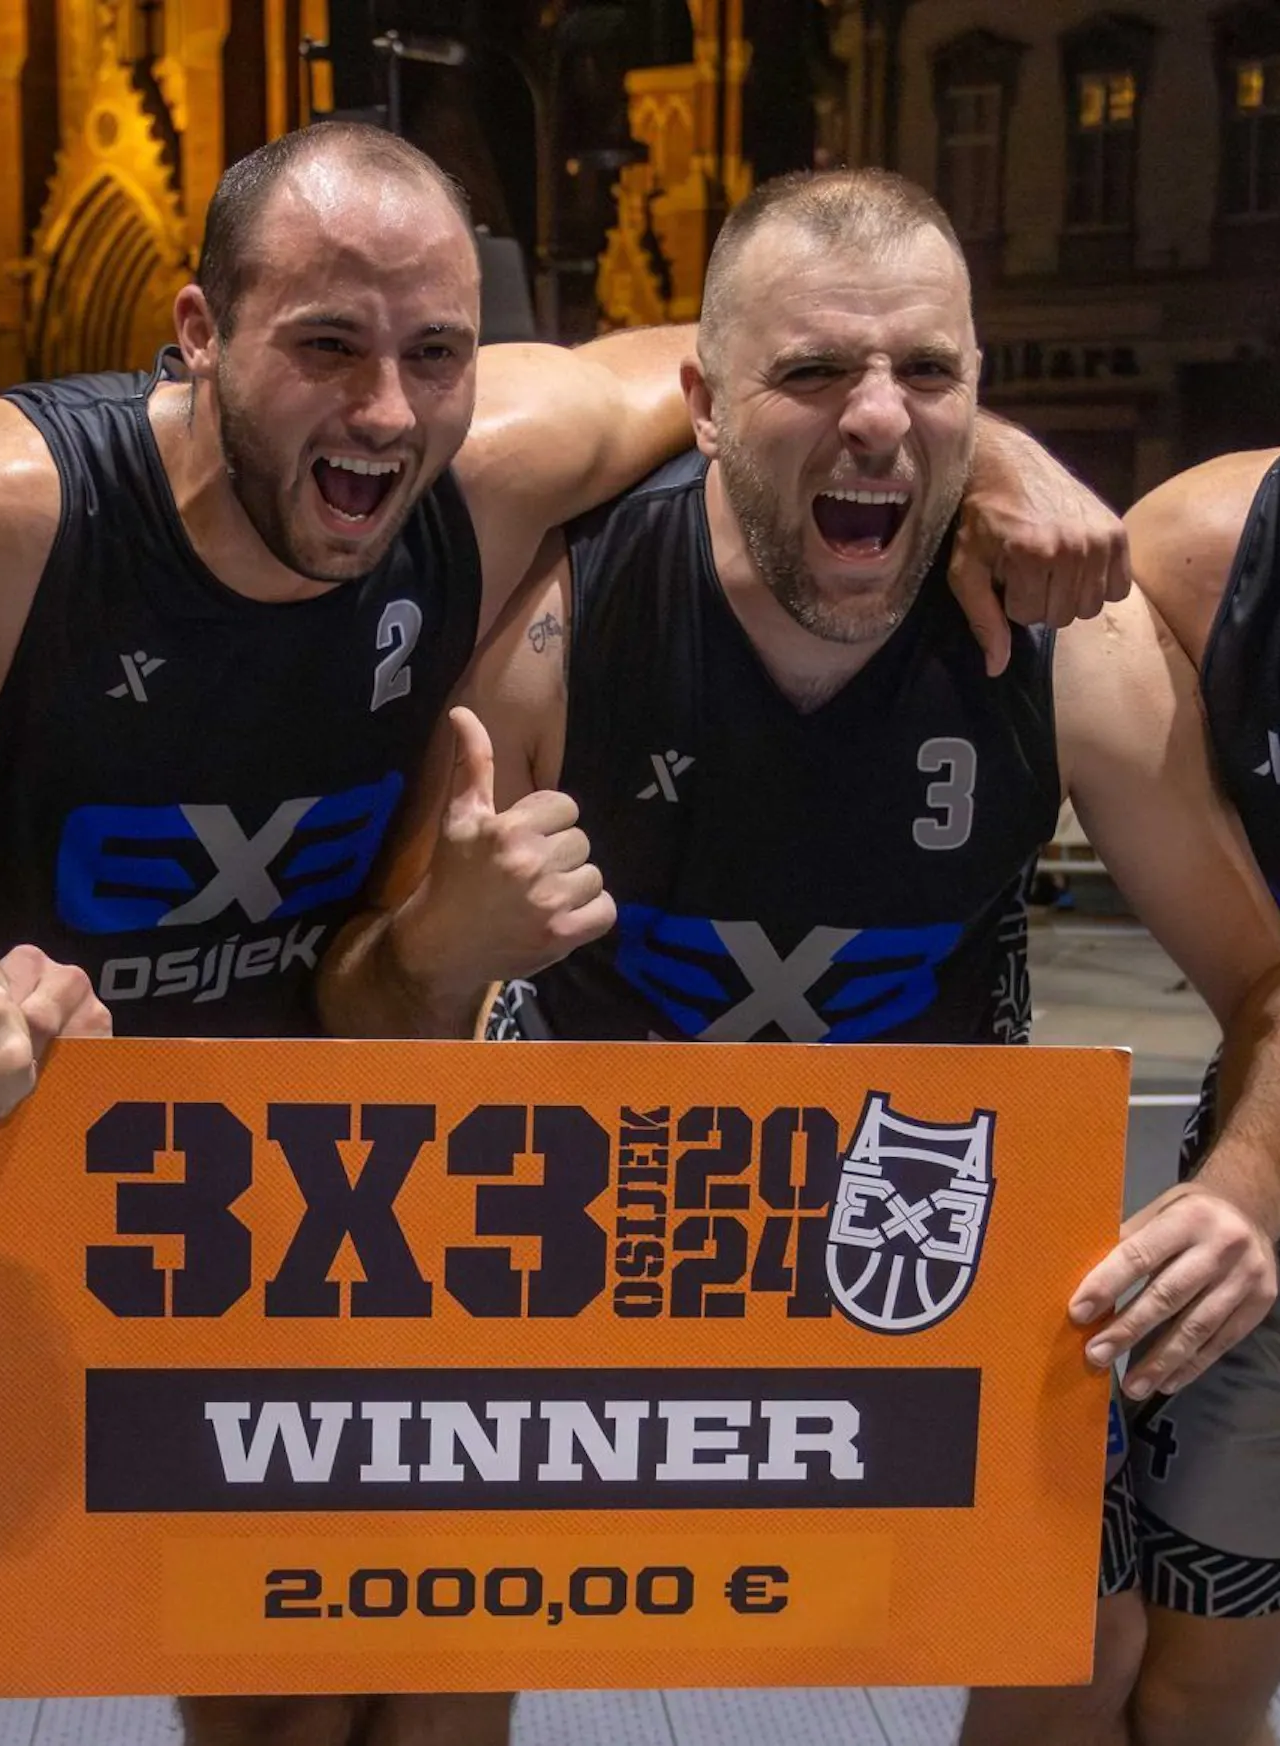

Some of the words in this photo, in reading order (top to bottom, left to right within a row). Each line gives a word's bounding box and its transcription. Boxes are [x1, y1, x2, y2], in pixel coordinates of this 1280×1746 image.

[371, 598, 423, 712] 2
[912, 736, 978, 850] 3
[86, 1101, 611, 1318] 3X3
[613, 1105, 671, 1319] OSIJEK
[674, 1105, 840, 1210] 20
[669, 1215, 834, 1318] 24
[205, 1400, 865, 1483] WINNER
[264, 1565, 694, 1627] 2.000,00
[724, 1563, 789, 1616] €
